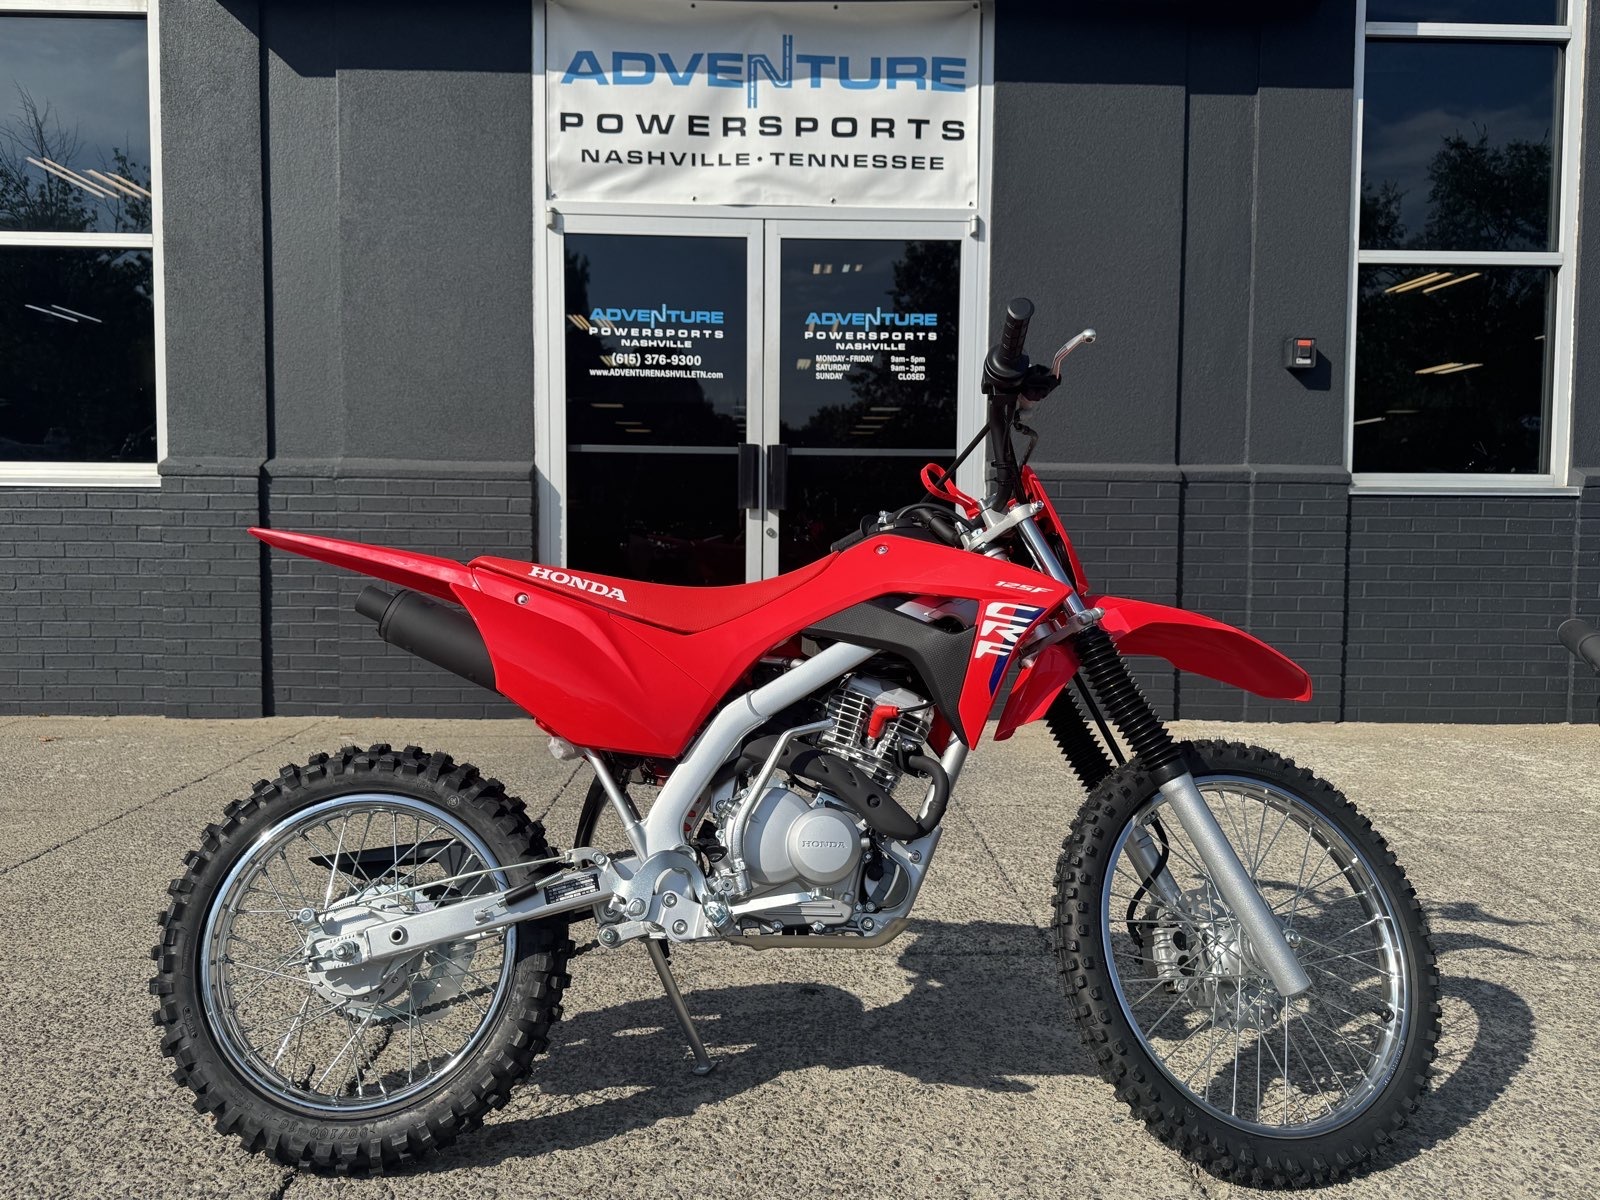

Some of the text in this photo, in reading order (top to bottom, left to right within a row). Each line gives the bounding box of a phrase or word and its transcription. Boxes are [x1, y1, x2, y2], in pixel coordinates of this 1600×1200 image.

[560, 34, 967, 108] ADVENTURE
[560, 112, 966, 141] POWERSPORTS
[581, 149, 945, 170] NASHVILLE TENNESSEE
[589, 303, 724, 328] ADVENTURE
[805, 307, 938, 332] ADVENTURE
[589, 327, 724, 338] POWERSPORTS
[804, 331, 938, 341] POWERSPORTS
[621, 339, 692, 348] NASHVILLE
[836, 343, 906, 351] NASHVILLE
[611, 353, 702, 367] (615) 376-9300
[589, 368, 724, 379] www.ADVENTURENASHVILLETN.com
[816, 363, 851, 372] SATURDAY
[816, 372, 844, 380] SUNDAY
[897, 372, 926, 381] CLOSED
[527, 565, 628, 603] HONDA
[994, 580, 1056, 593] 125F
[974, 601, 1040, 659] CRF
[801, 840, 848, 849] HONDA
